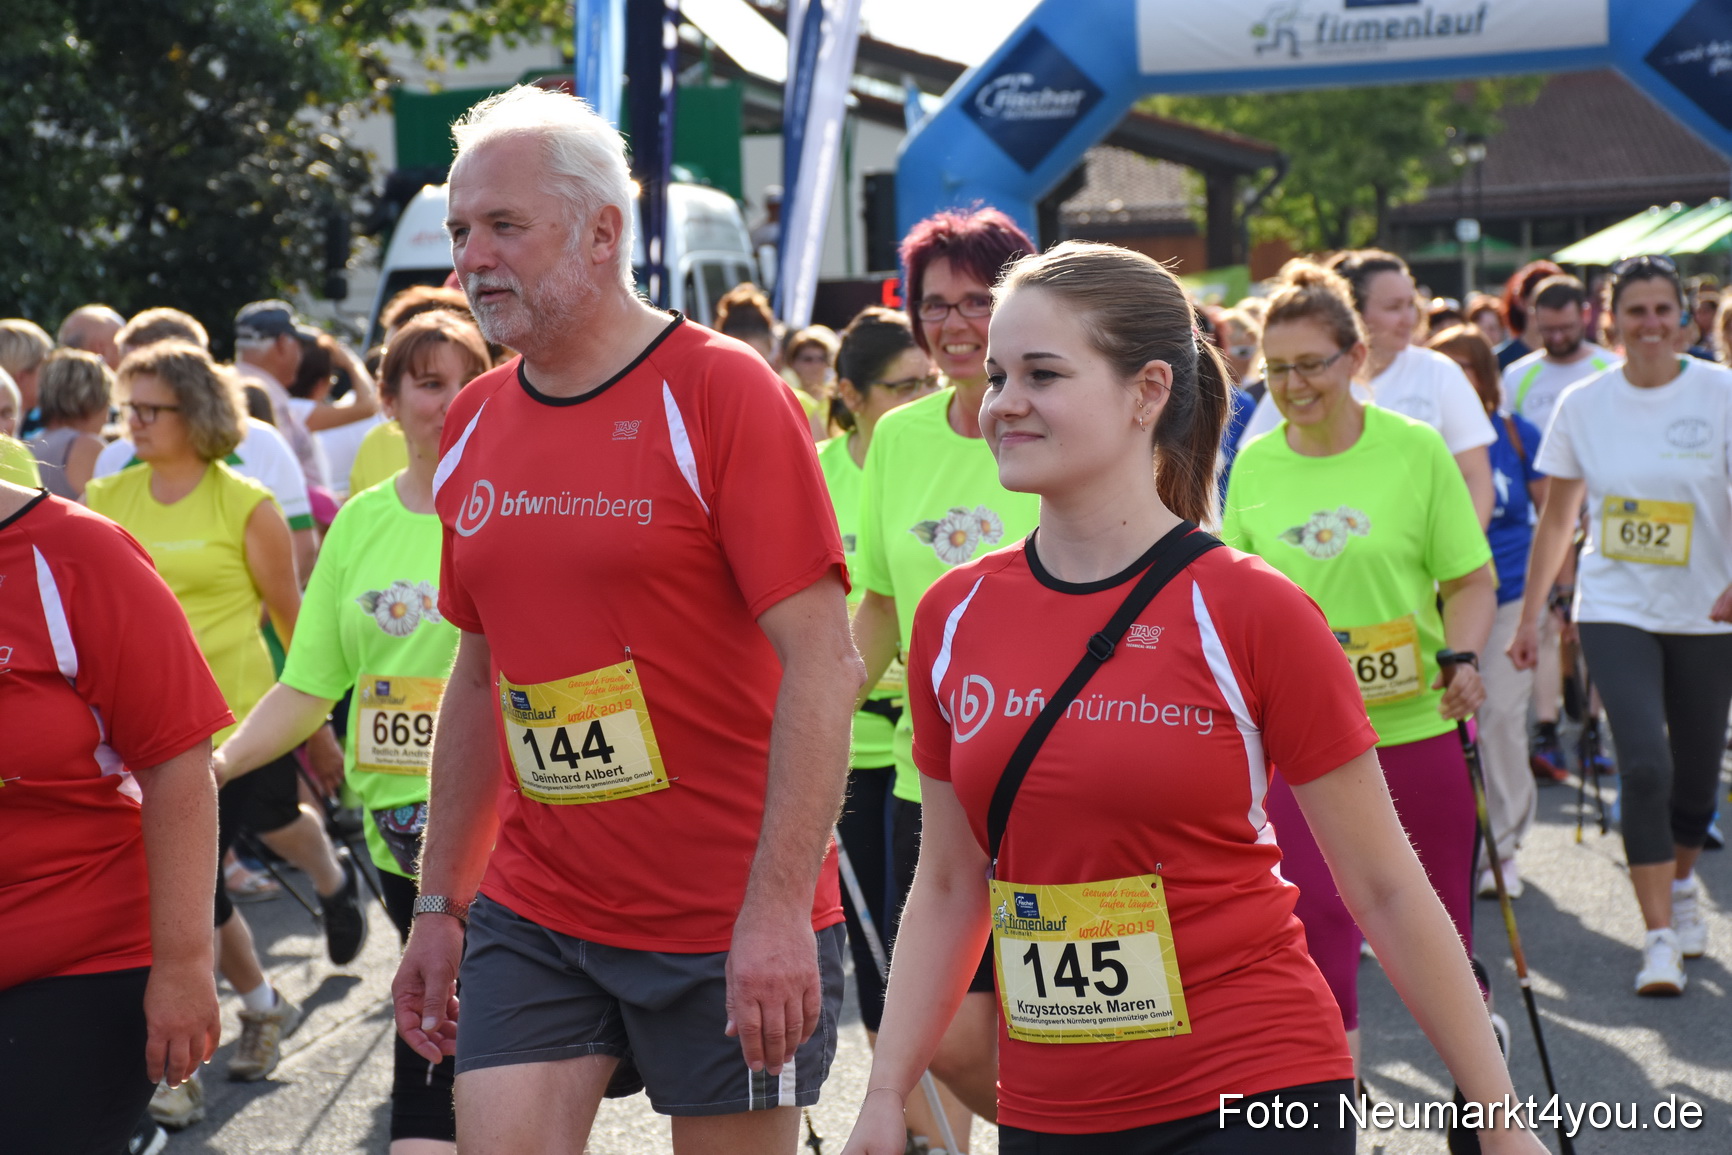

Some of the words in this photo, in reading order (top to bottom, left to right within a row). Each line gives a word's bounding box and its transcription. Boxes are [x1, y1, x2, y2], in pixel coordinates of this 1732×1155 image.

[1316, 2, 1487, 43] firmenlauf
[614, 420, 640, 431] TAO
[500, 491, 652, 525] bfwnürnberg
[1620, 519, 1671, 547] 692
[1130, 623, 1162, 638] TAO
[1348, 651, 1398, 683] 68
[567, 704, 600, 723] walk
[600, 699, 633, 717] 2019
[373, 711, 433, 747] 669
[522, 720, 615, 770] 144
[531, 771, 581, 784] Deinhard
[585, 765, 624, 781] Albert
[564, 783, 590, 791] Nürnberg
[591, 776, 633, 788] gemeinnützige
[633, 770, 653, 779] GmbH
[1082, 887, 1118, 898] Gesunde
[1120, 887, 1150, 898] Firmen
[1009, 914, 1067, 931] firmenlauf
[1079, 920, 1114, 938] walk
[1117, 920, 1155, 936] 2019
[1023, 940, 1129, 998] 145
[1016, 1000, 1103, 1018] Krzysztoszek
[1106, 998, 1156, 1013] Maren
[1066, 1017, 1097, 1025] Nürnberg
[1098, 1013, 1149, 1024] gemeinnützige
[1150, 1010, 1173, 1019] GmbH
